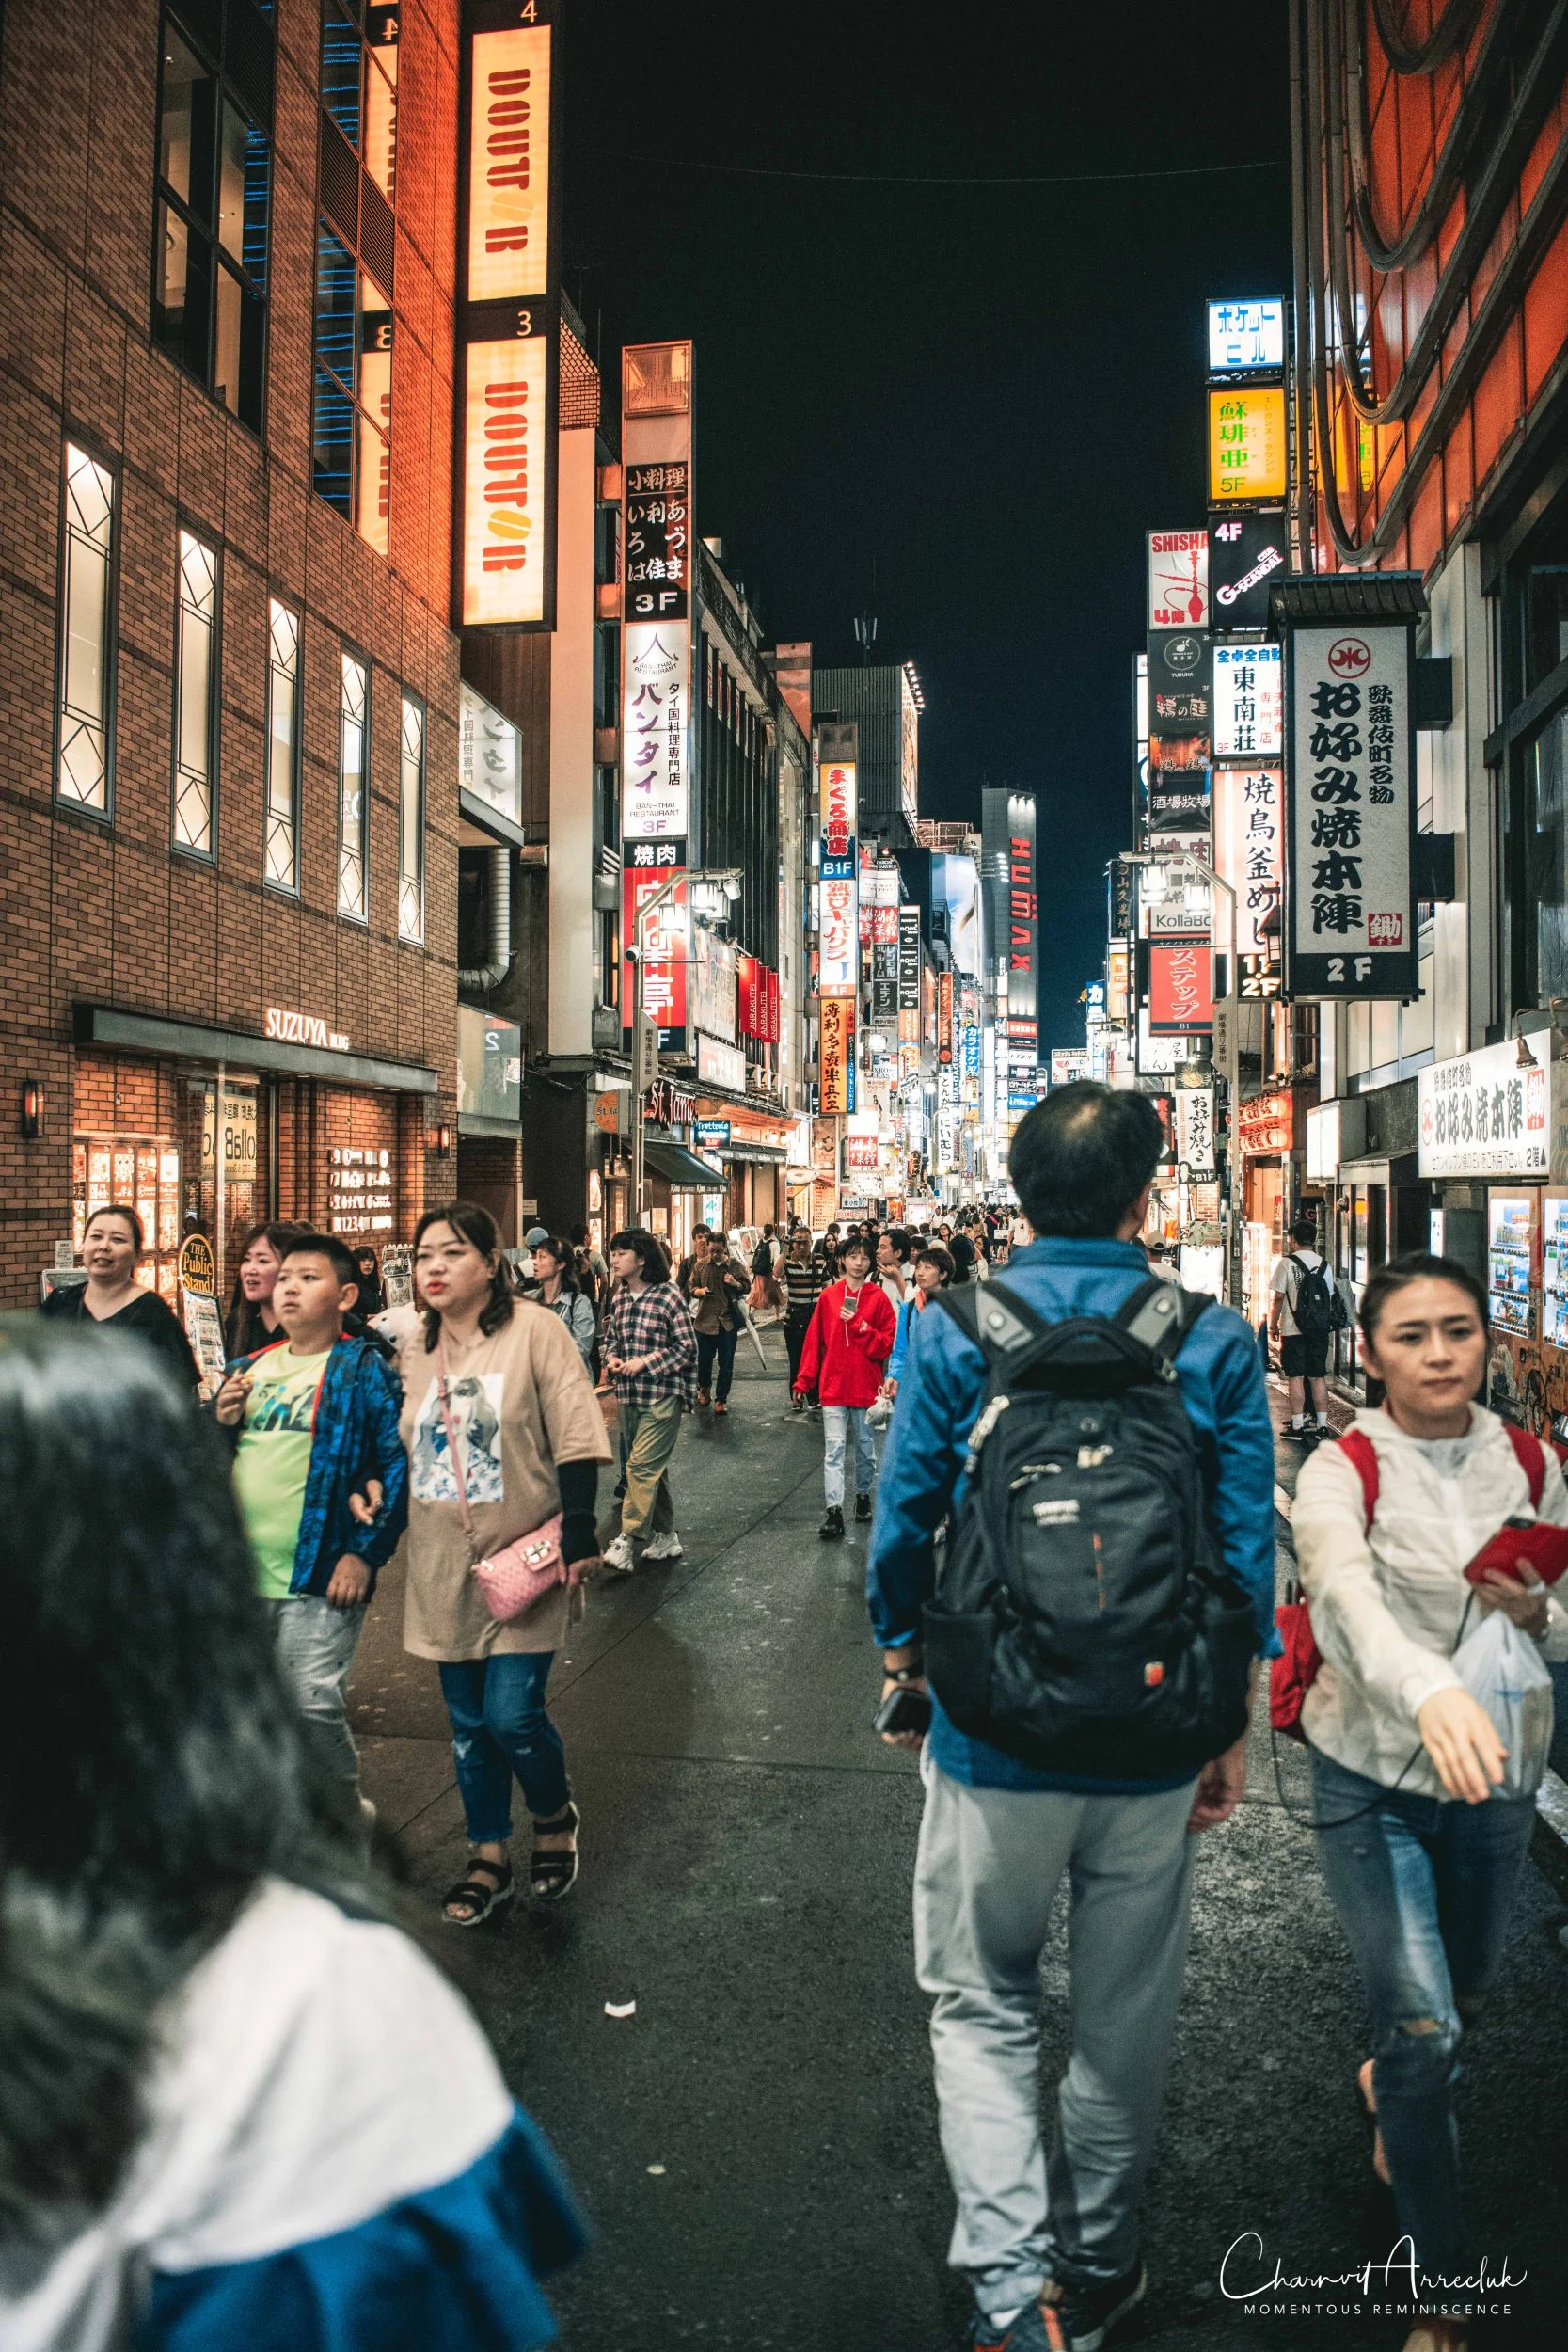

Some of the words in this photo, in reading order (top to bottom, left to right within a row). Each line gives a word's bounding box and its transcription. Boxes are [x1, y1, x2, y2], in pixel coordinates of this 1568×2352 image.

[521, 0, 539, 24] 4
[484, 68, 535, 255] DOUTOR
[517, 310, 532, 337] 3
[483, 380, 532, 573] DOUTOR
[628, 467, 686, 491] 小料理
[1219, 477, 1247, 493] 5F
[1151, 532, 1209, 553] SHISHA
[1214, 522, 1243, 542] 4F
[635, 591, 678, 613] 3F
[1153, 608, 1187, 625] 4階
[1217, 648, 1281, 664] 全卓全自動
[1233, 666, 1256, 753] 東南荘
[631, 682, 663, 794] バンタイ
[668, 682, 681, 787] タイ国料理専門店
[1367, 685, 1395, 804] 歌舞伎町名物
[1216, 742, 1229, 754] 3F
[636, 801, 675, 811] BAN-THAI
[828, 769, 850, 856] まぐろ商店
[1152, 795, 1211, 809] 酒場牧場
[1309, 682, 1362, 935] お好み焼本陣
[629, 810, 680, 819] RESTAURANT
[642, 819, 667, 834] 3F
[634, 845, 677, 866] 焼肉
[1243, 772, 1277, 946] 焼鳥釜めし
[823, 862, 853, 875] B1F
[1010, 837, 1037, 972] HUMAX
[1327, 957, 1372, 983] 2F
[829, 985, 849, 995] 4F
[1167, 946, 1201, 1021] ステップ
[749, 983, 757, 1033] ANRAKUTEI
[760, 990, 768, 1038] ANRAKUTEI
[770, 996, 779, 1041] ANRAKUTEI
[265, 1007, 329, 1048] SUZUYA
[658, 1029, 671, 1049] F
[698, 1120, 729, 1131] Trattoria
[1188, 1095, 1212, 1163] お好み焼き
[1196, 1172, 1214, 1183] B1F
[190, 1242, 206, 1256] THE
[182, 1252, 214, 1276] Public
[182, 1272, 213, 1293] Stand
